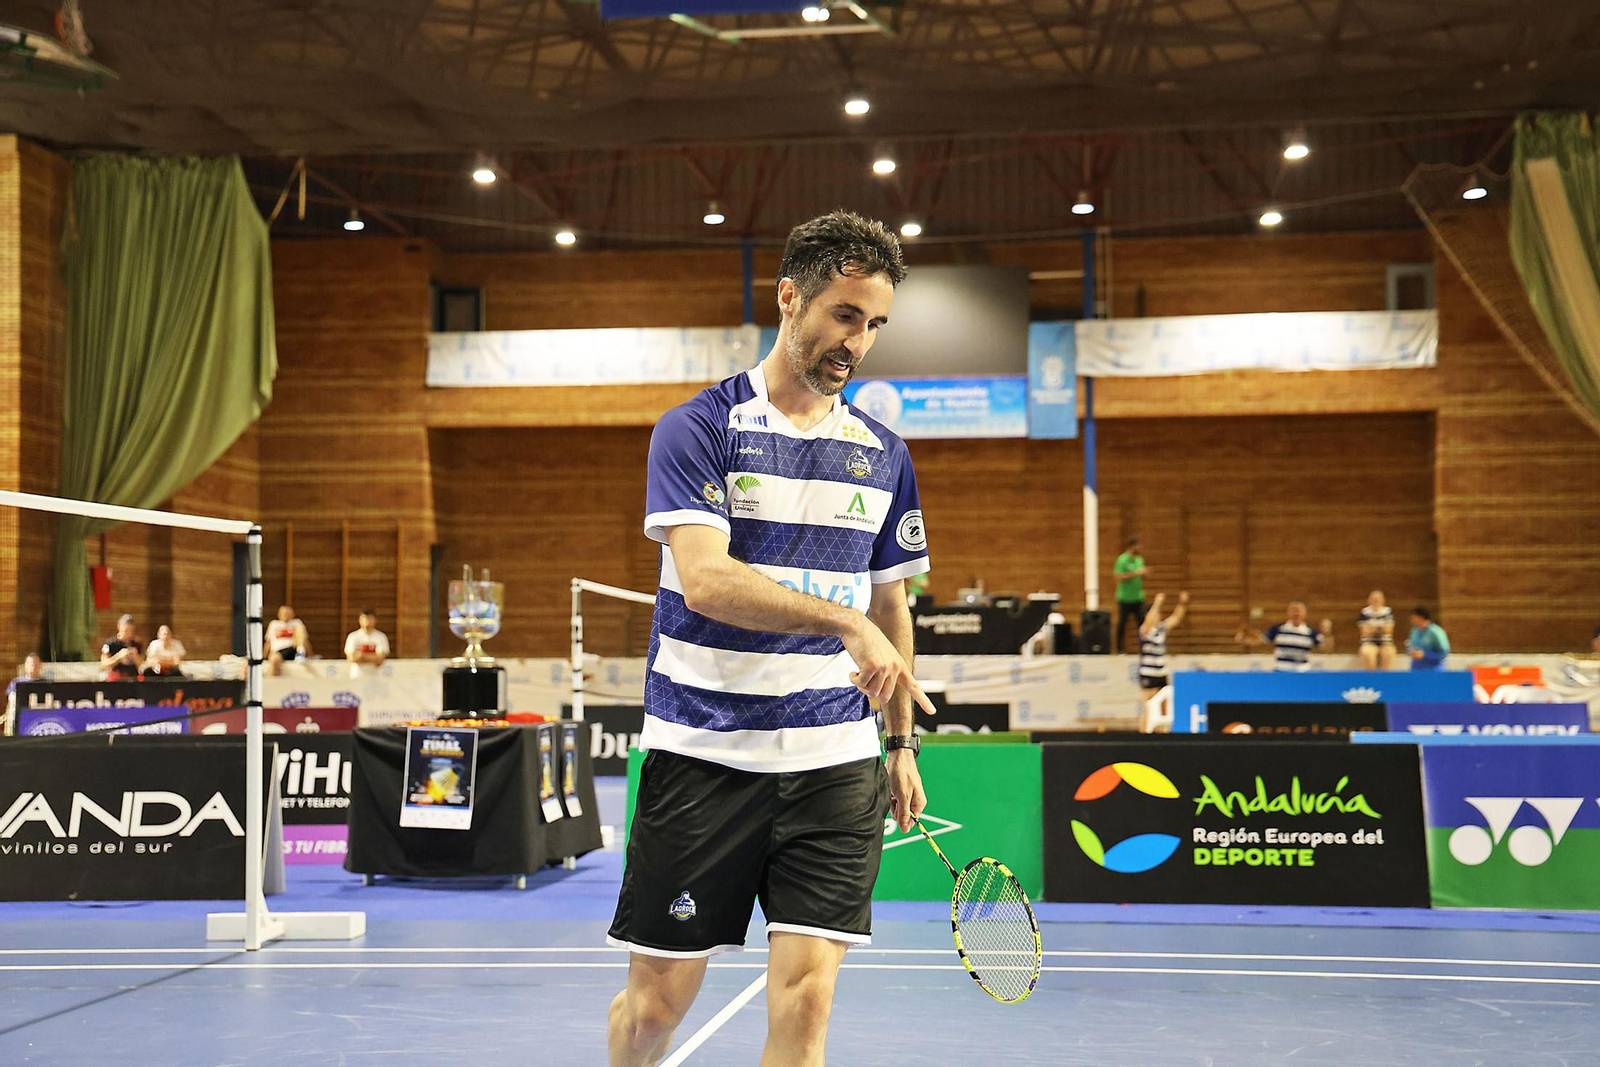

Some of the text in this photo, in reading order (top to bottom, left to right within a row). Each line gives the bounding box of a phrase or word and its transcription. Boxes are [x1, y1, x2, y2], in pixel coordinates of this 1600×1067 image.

[1192, 774, 1383, 820] Andalucía
[295, 840, 314, 854] TU
[313, 840, 349, 854] FIBR
[1192, 827, 1385, 848] Región Europea del
[0, 841, 174, 855] vinilos del sur
[1193, 848, 1315, 867] DEPORTE
